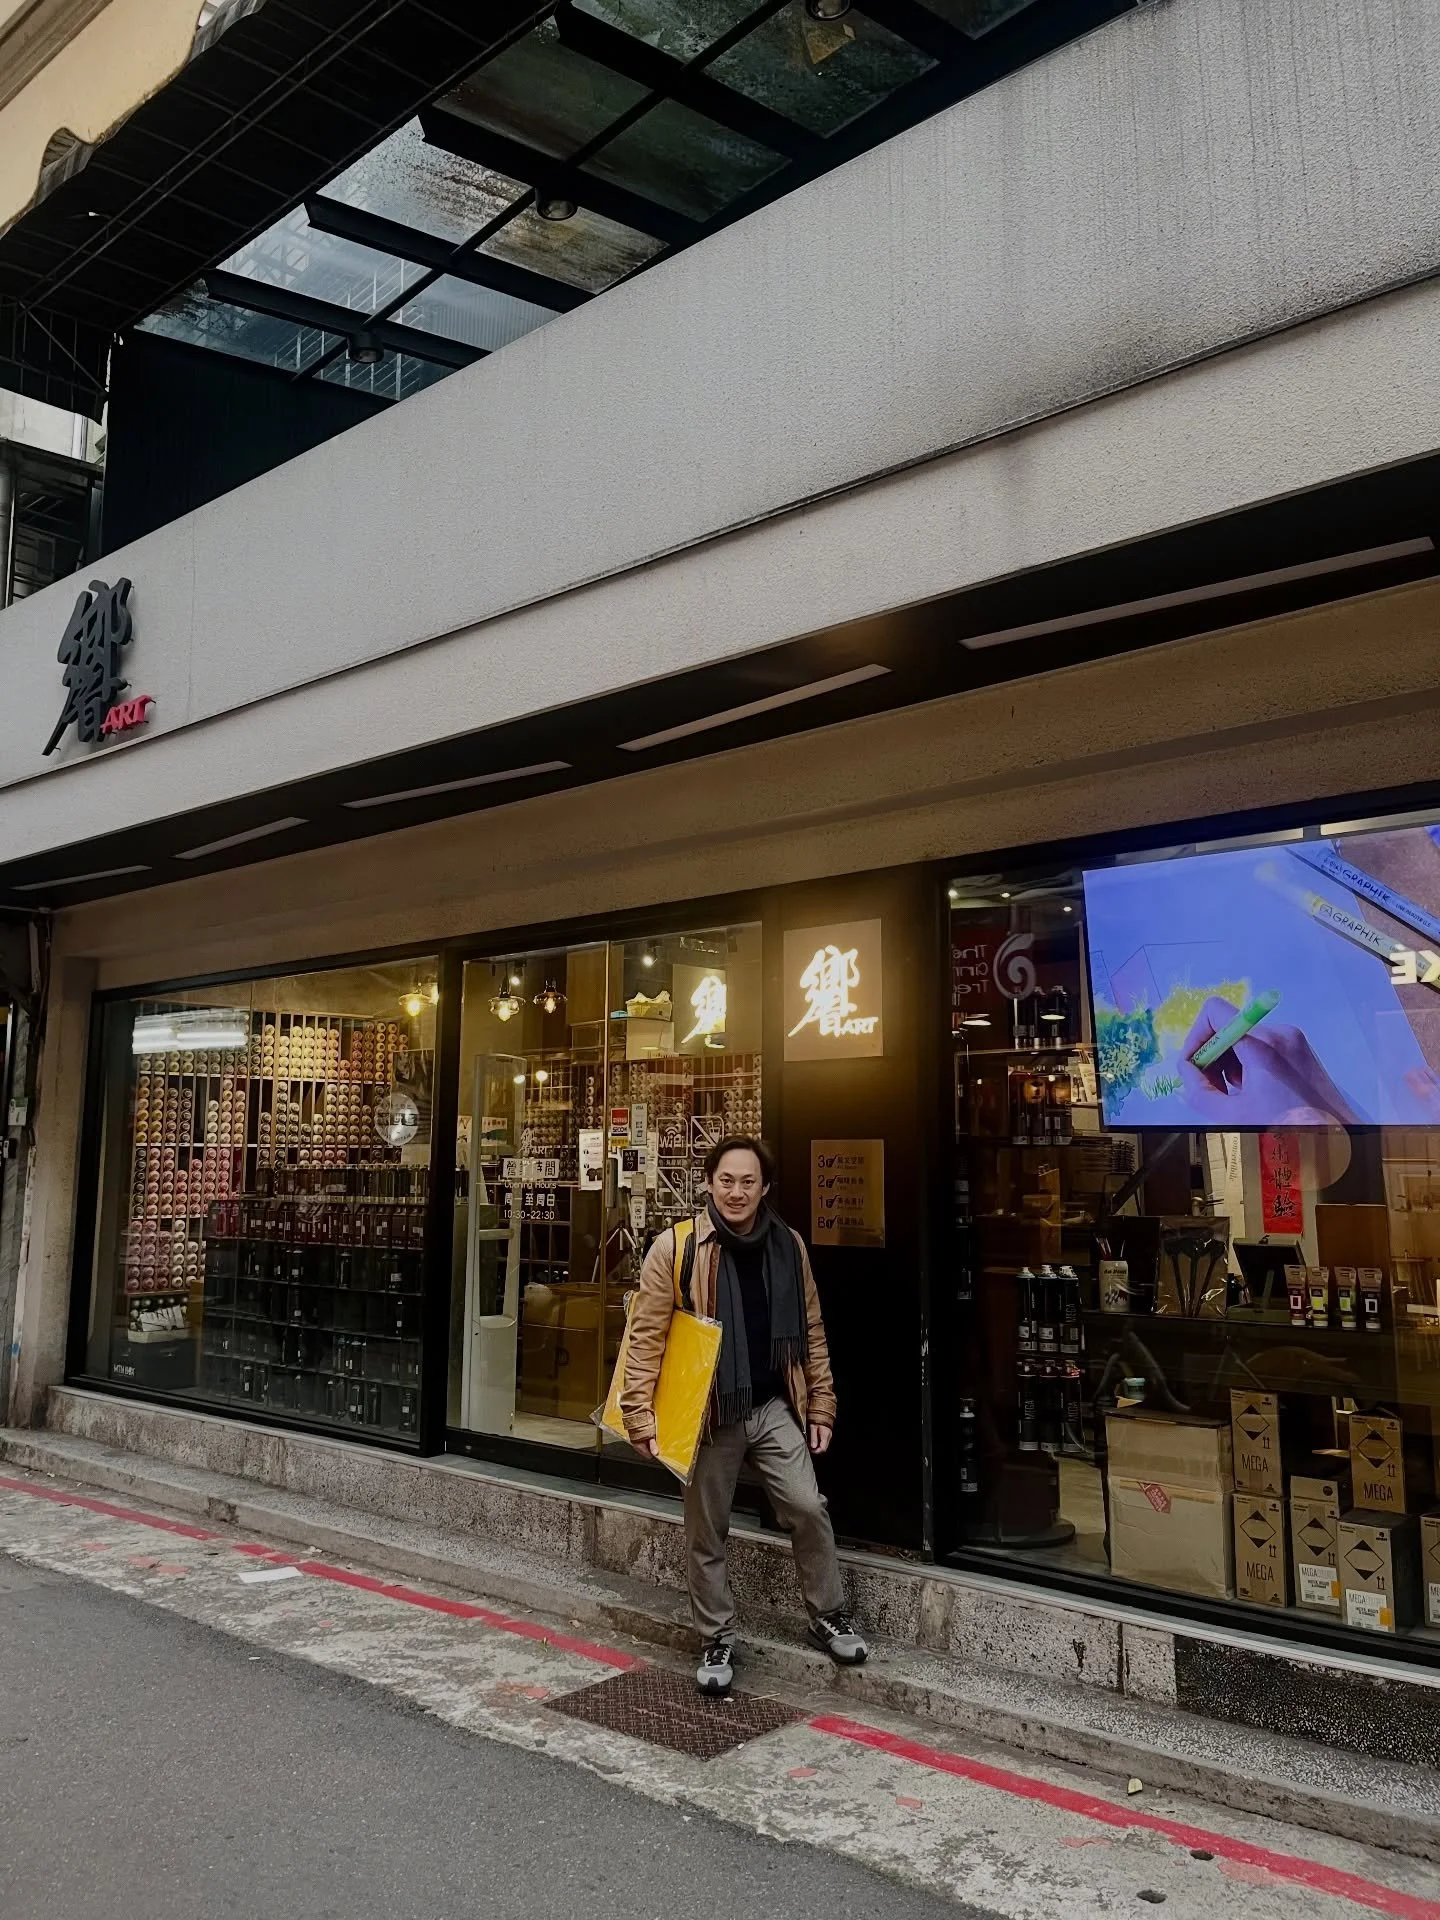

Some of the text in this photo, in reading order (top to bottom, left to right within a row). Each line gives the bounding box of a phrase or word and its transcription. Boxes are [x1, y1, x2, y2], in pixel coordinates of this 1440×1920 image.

[101, 694, 155, 734] ART
[841, 1017, 878, 1034] ART
[507, 1160, 556, 1177] 營時間
[1269, 1132, 1296, 1218] 術體驗
[535, 1181, 557, 1189] Hours
[504, 1209, 555, 1220] 10:30-22:30
[1241, 1453, 1269, 1473] MEGA
[1362, 1481, 1394, 1502] MEGA
[1246, 1561, 1275, 1582] MEGA
